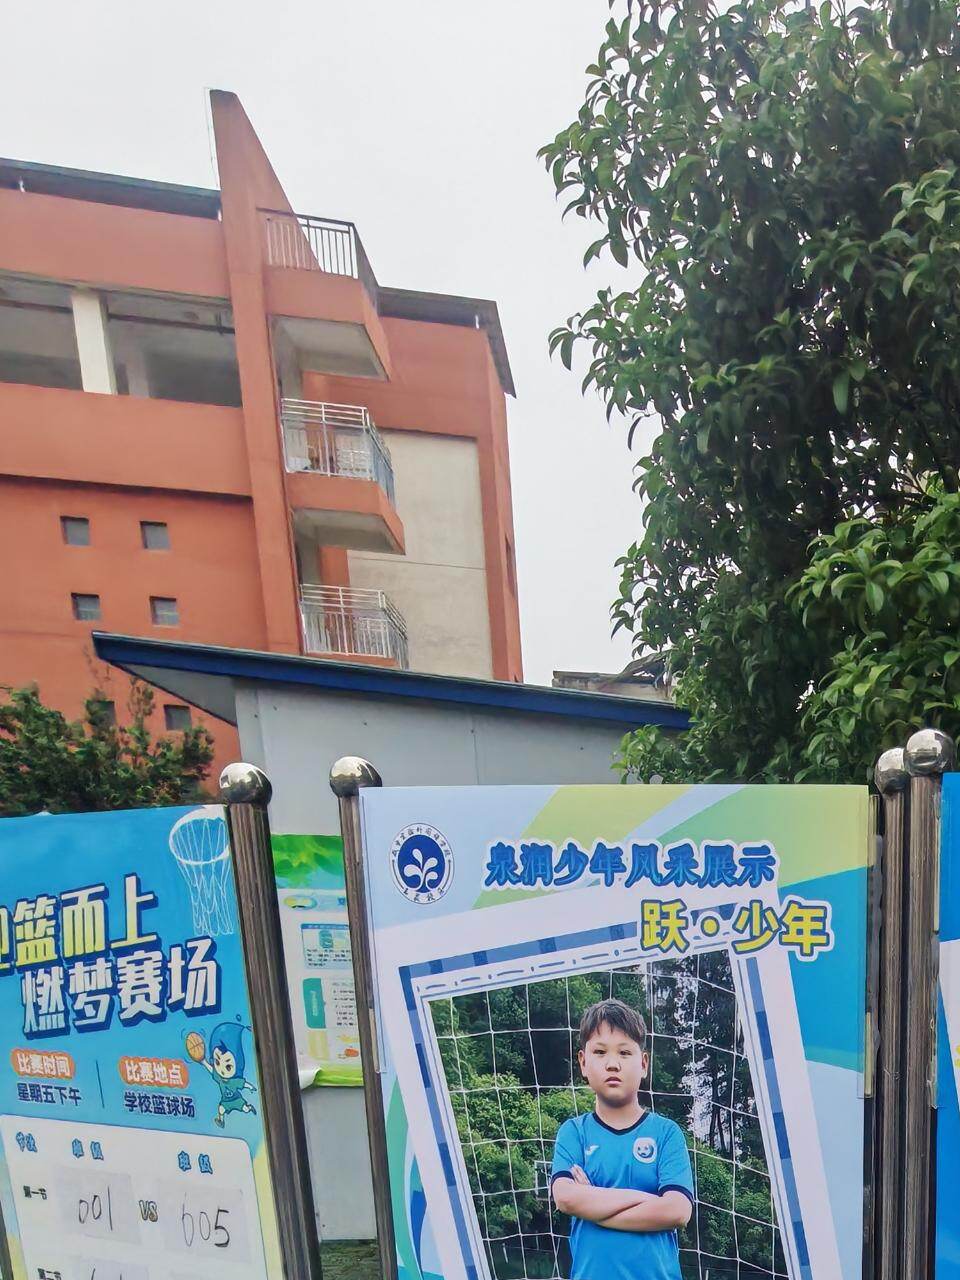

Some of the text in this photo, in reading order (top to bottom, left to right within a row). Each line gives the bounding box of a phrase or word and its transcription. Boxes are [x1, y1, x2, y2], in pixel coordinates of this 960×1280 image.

[485, 841, 778, 889] 泉润少年风采展示
[22, 937, 221, 1037] 燃梦赛场
[16, 1053, 72, 1077] 比赛时间
[124, 1060, 184, 1085] 比赛地点
[17, 1083, 82, 1106] 星期五下午
[124, 1091, 196, 1118] 学校篮球场
